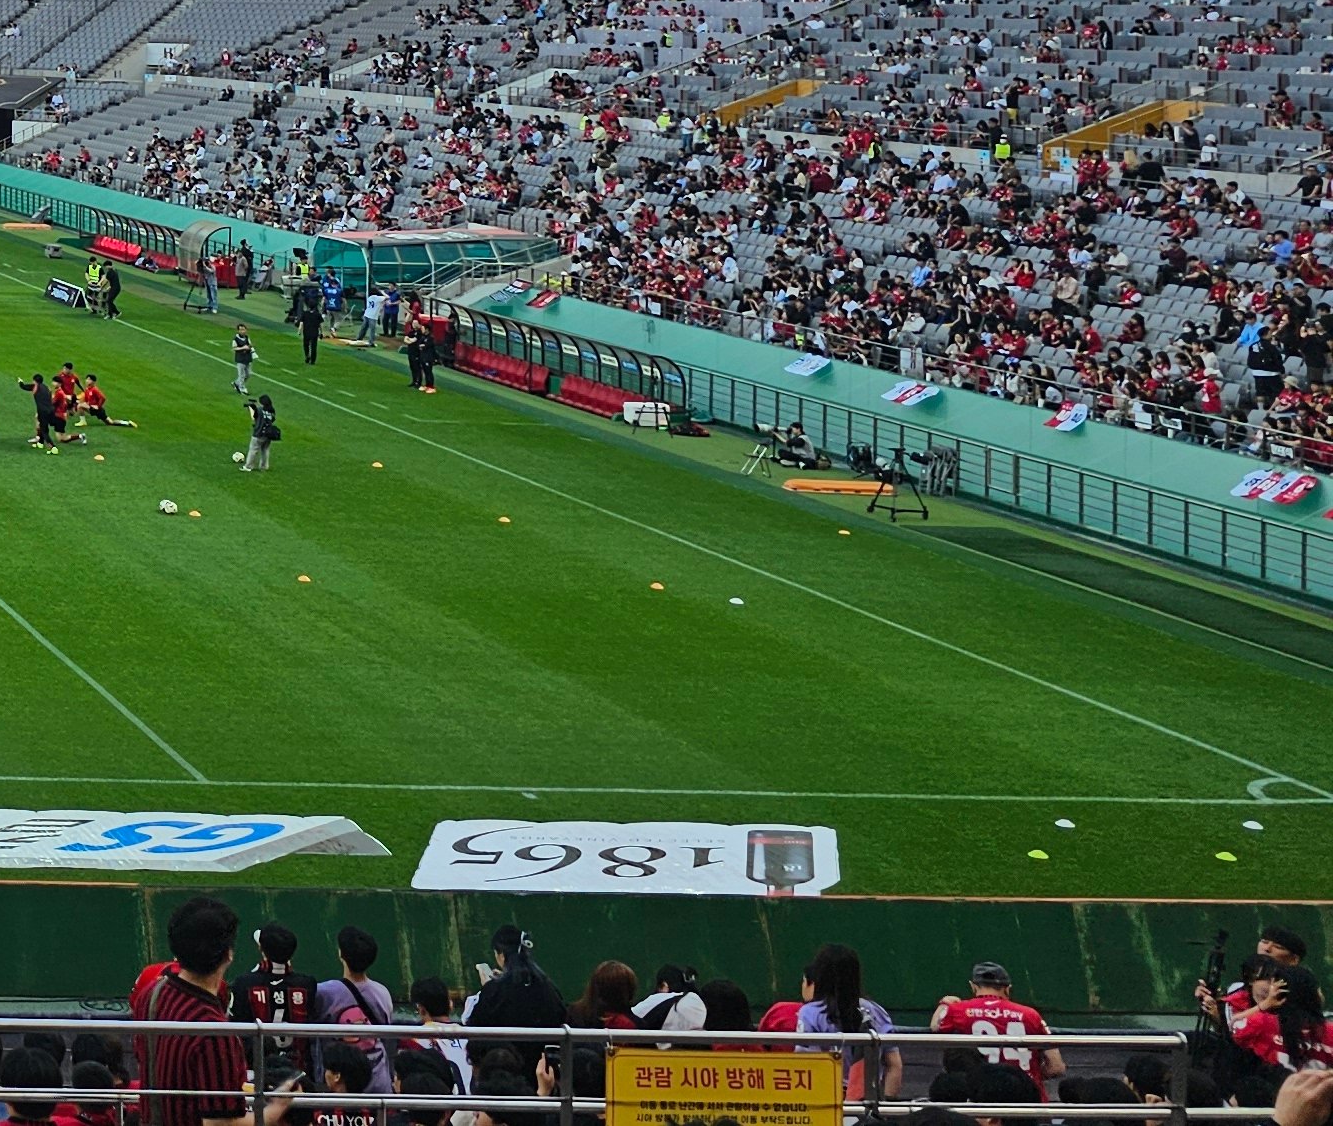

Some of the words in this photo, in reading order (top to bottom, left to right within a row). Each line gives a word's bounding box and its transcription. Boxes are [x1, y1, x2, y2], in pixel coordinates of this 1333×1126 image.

[51, 820, 286, 855] GS
[448, 825, 726, 882] 1865
[635, 1066, 673, 1090] 관람
[680, 1067, 720, 1090] 시야
[726, 1067, 766, 1092] 방해
[772, 1068, 813, 1093] 금지
